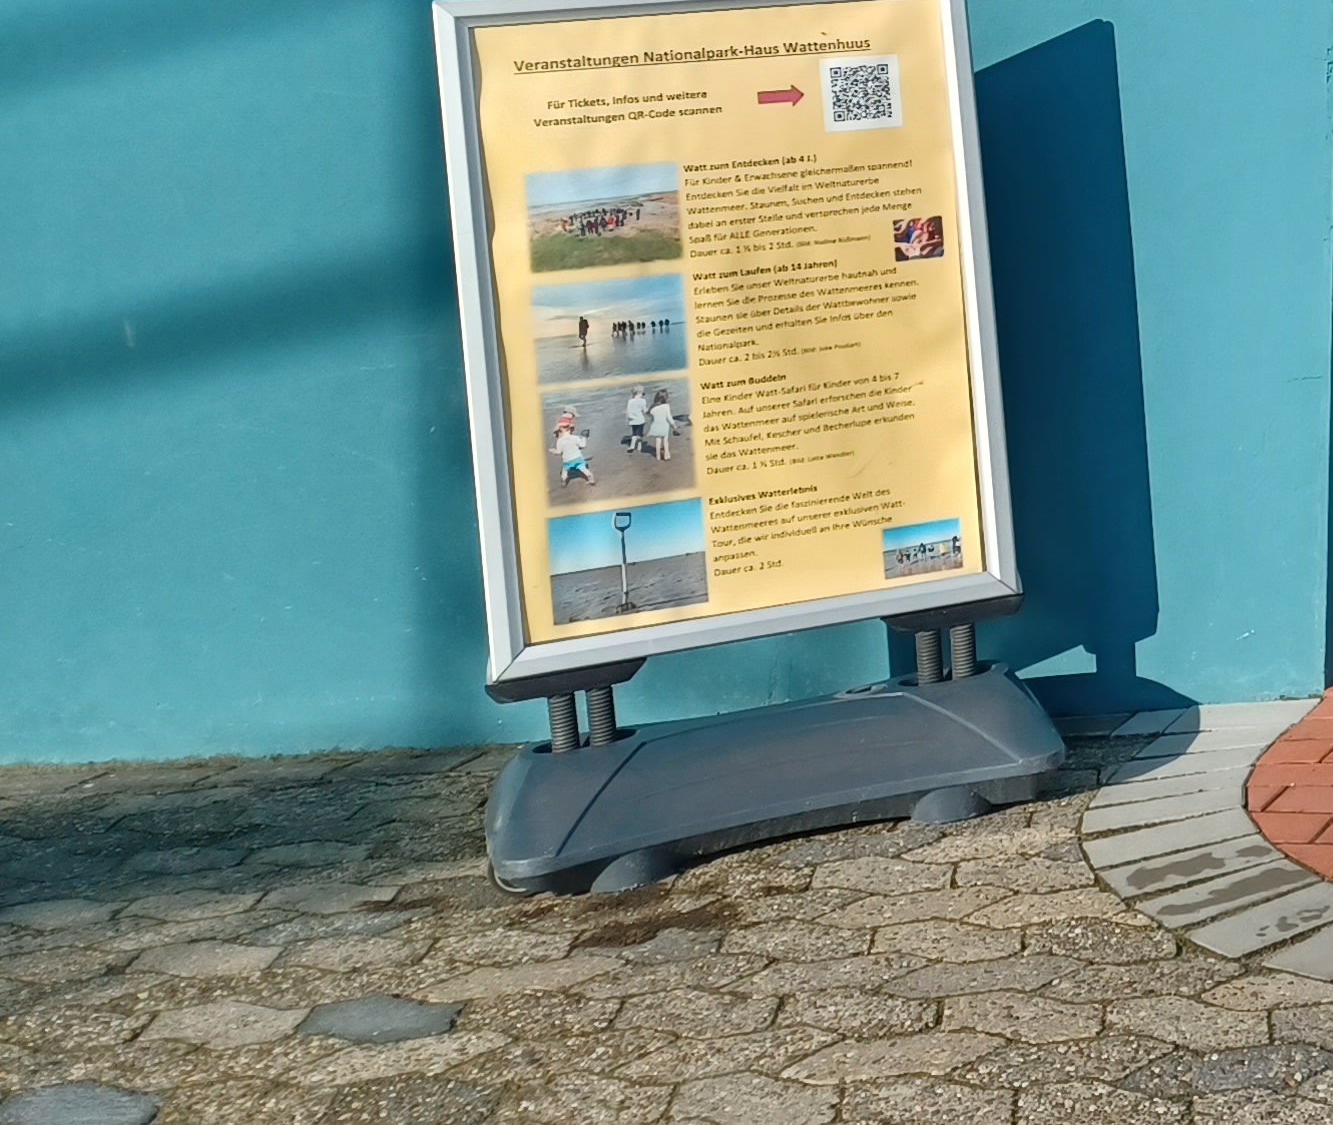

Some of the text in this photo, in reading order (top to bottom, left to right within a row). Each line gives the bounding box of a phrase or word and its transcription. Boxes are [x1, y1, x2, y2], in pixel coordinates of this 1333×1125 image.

[514, 38, 870, 72] Veranstaltungen Nationalpark-Haus Wattenhuus
[547, 91, 707, 109] Für Tickets, Infos und weitere
[533, 106, 722, 126] Veranstaltungen QR-Code scannen
